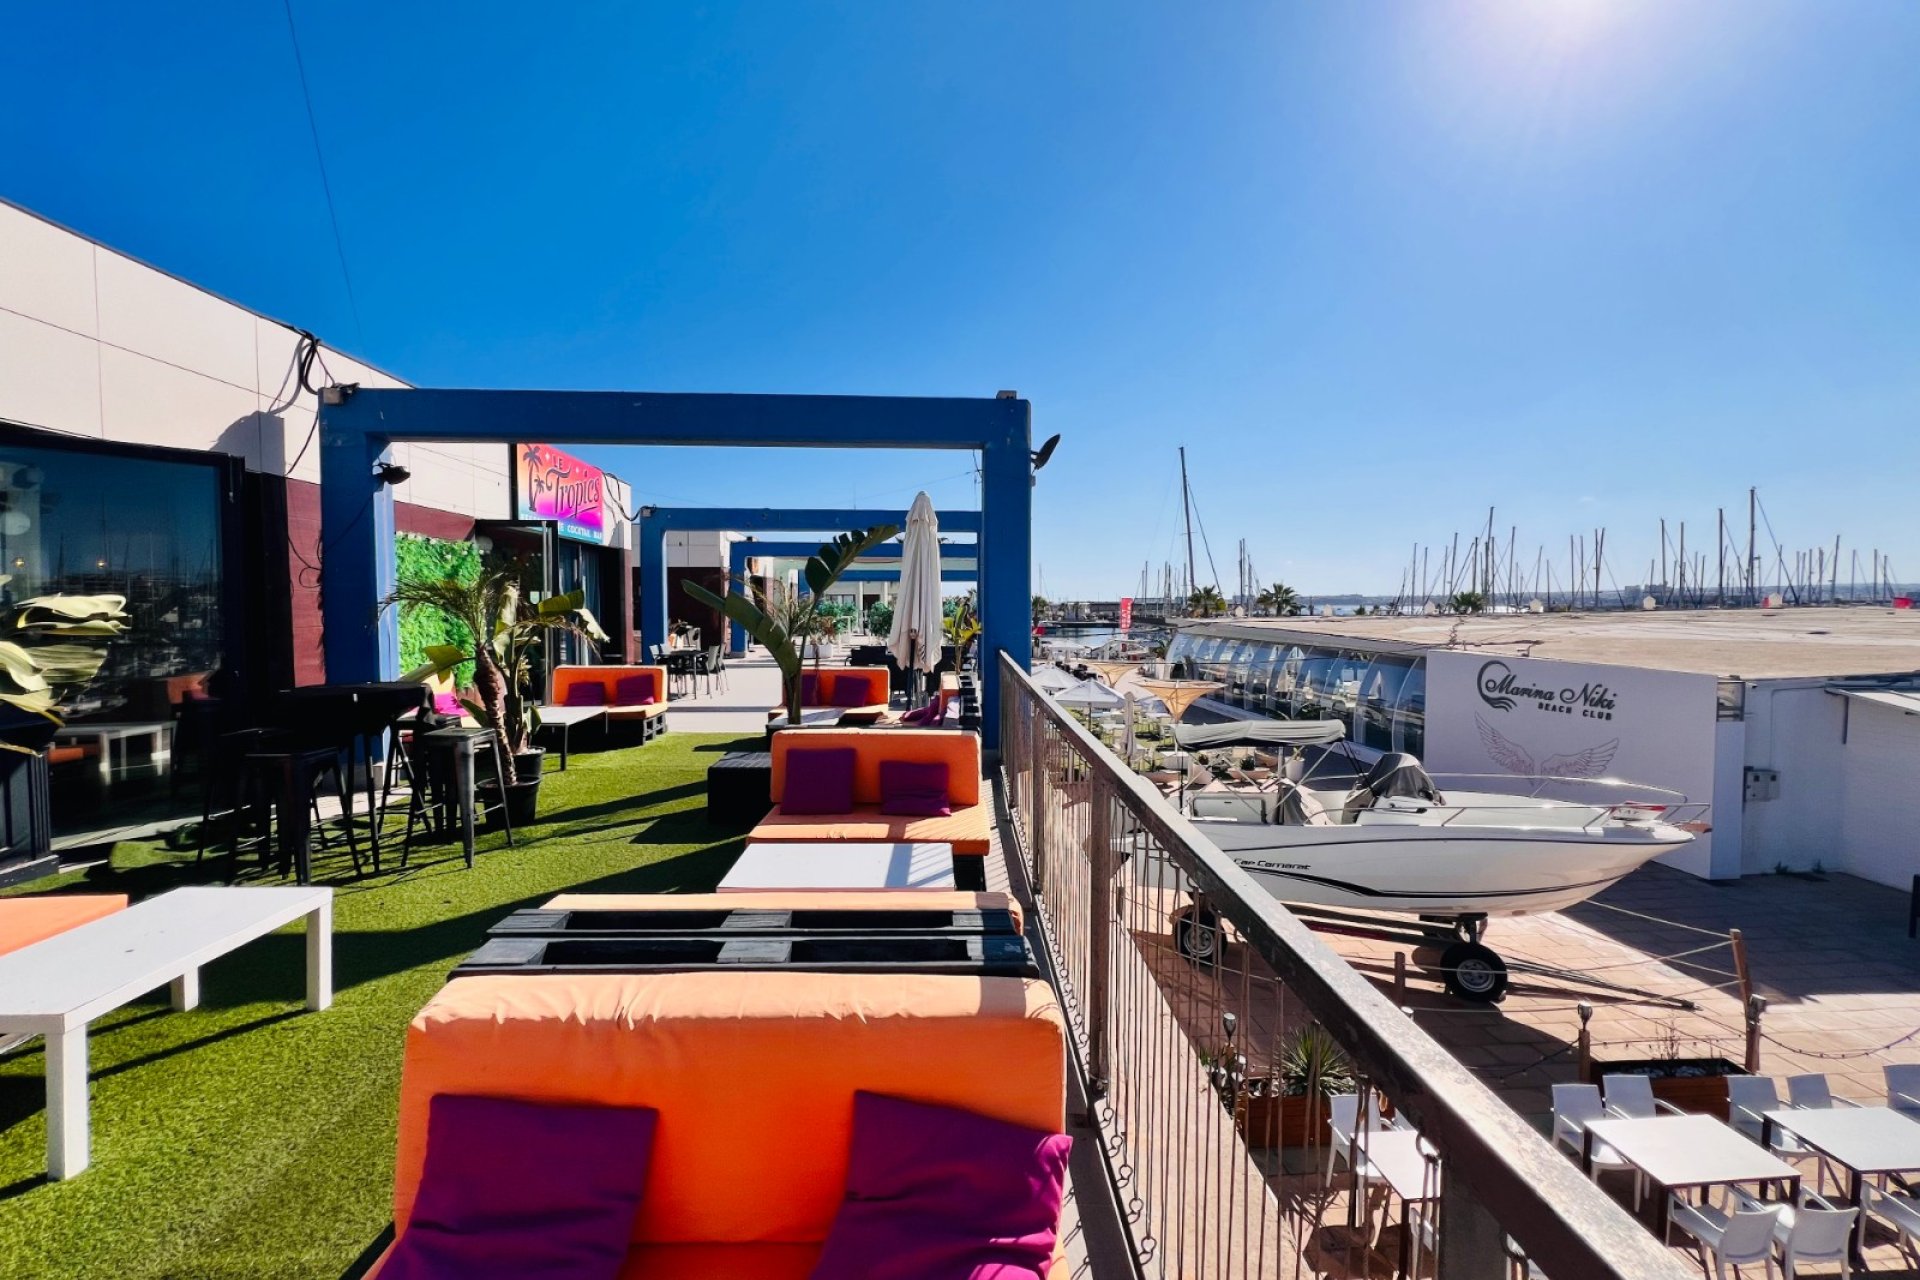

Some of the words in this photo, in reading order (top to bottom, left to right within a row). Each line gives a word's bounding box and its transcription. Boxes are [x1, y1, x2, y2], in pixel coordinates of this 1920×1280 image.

[552, 455, 563, 470] LE
[545, 467, 600, 519] Tropics
[1485, 674, 1555, 701] Marina
[1559, 682, 1618, 711] Niki
[1537, 702, 1572, 714] BEACH
[1582, 709, 1613, 721] CLUB
